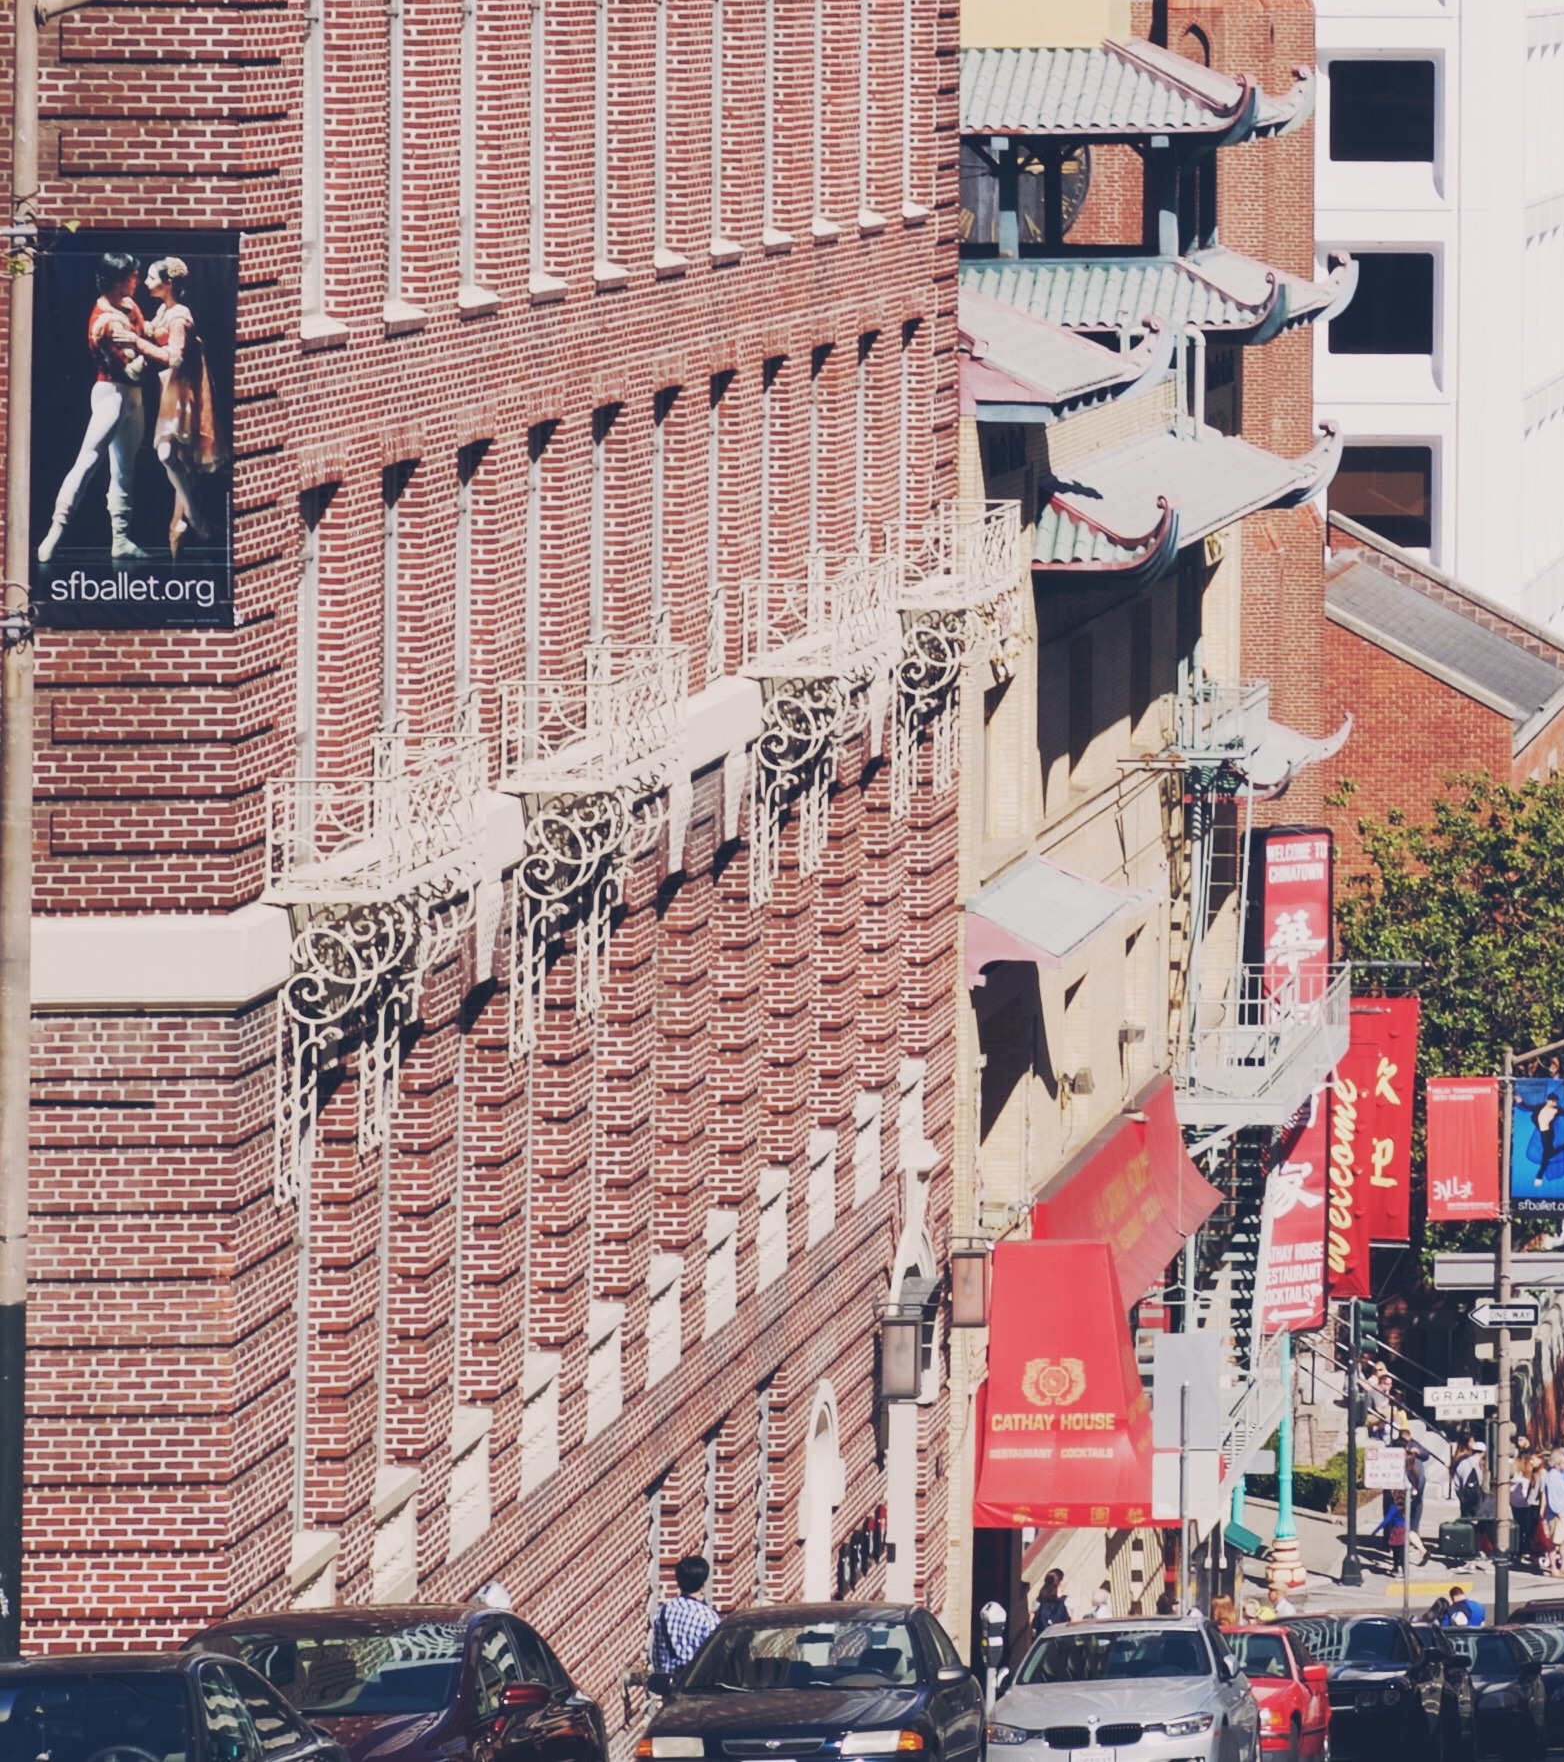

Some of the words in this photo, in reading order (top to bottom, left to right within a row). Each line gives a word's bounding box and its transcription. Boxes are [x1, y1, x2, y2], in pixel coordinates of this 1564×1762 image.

[51, 571, 215, 607] sfballet.org
[1265, 842, 1312, 862] WELCOME
[1313, 840, 1328, 859] TO
[1268, 862, 1324, 884] CHINATOWN
[1328, 1078, 1358, 1274] Welcome
[1266, 1245, 1294, 1266] ATHAY
[1294, 1241, 1324, 1261] HOUSE
[1265, 1262, 1323, 1286] ESTAURANT
[1263, 1283, 1311, 1307] OCKTAILS
[1489, 1310, 1509, 1320] ONE
[1512, 1310, 1532, 1320] WAY
[1431, 1390, 1489, 1402] GRANT
[991, 1413, 1055, 1432] CATHAY
[1060, 1412, 1116, 1431] HOUSE
[989, 1448, 1053, 1460] RESTAURANT
[1060, 1447, 1114, 1459] COCKTAILS
